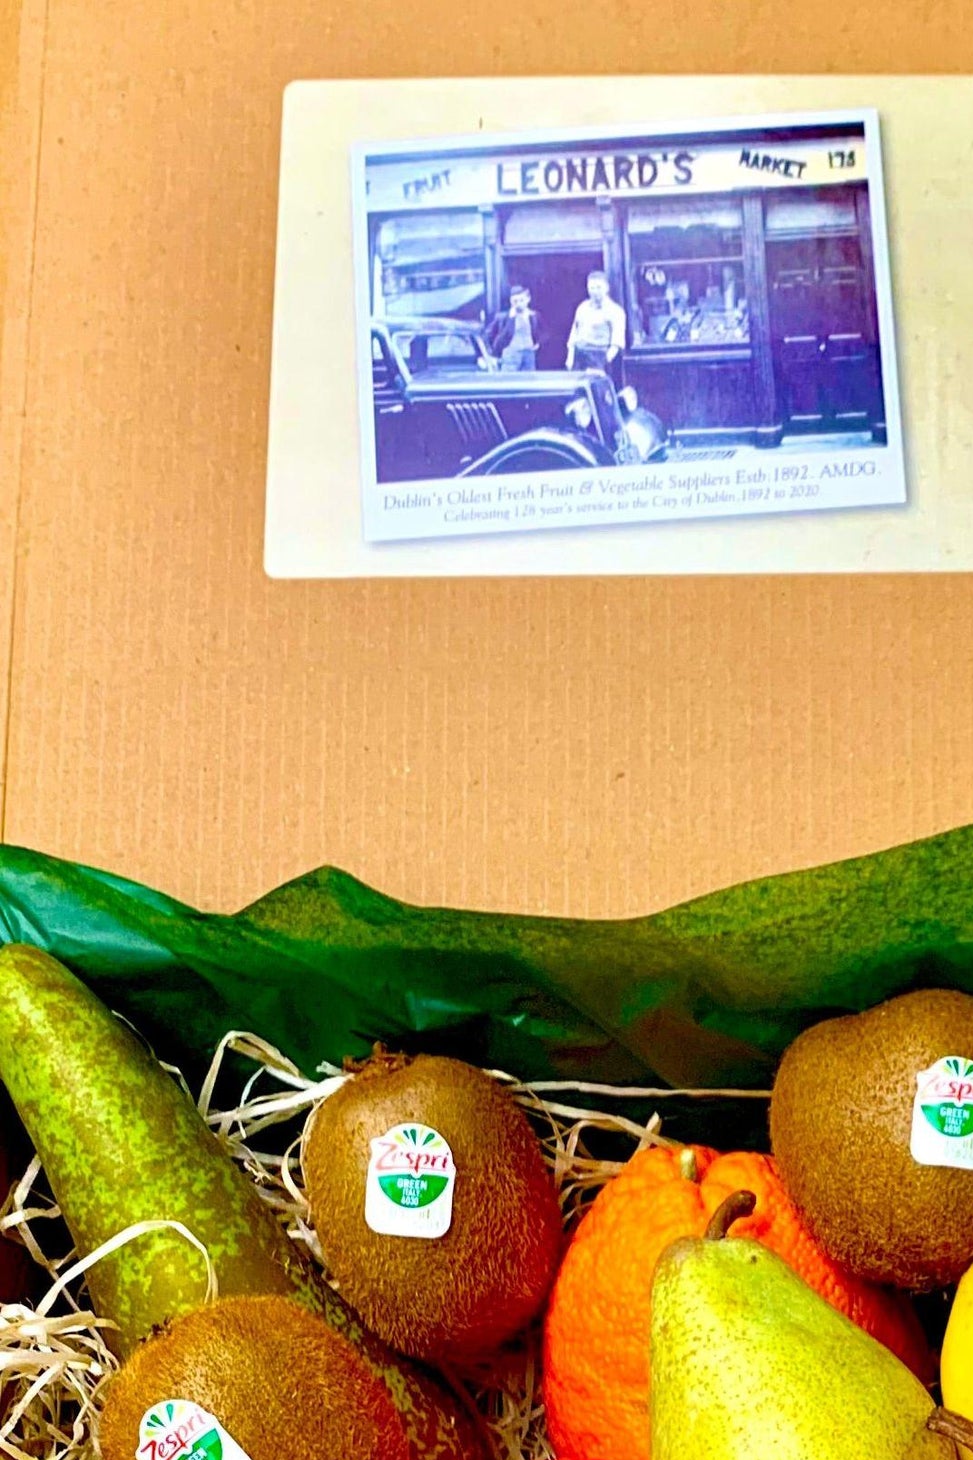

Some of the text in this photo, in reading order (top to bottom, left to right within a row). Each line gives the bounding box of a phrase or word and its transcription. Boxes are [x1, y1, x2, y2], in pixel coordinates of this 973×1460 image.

[402, 169, 451, 200] FRUIT
[497, 149, 694, 195] LEONARD'S
[739, 147, 807, 179] MARKET
[383, 493, 443, 511] Dublin's
[447, 489, 492, 506] Oldest
[498, 486, 535, 502] Fresh
[540, 483, 574, 499] Fruit
[579, 480, 593, 495] &
[598, 474, 663, 494] Vegetable
[669, 471, 730, 491] Suppliers
[444, 505, 510, 523] Celebrating
[540, 501, 573, 518] year's
[576, 500, 614, 514] service
[617, 499, 629, 510] to
[633, 496, 649, 509] the
[652, 494, 678, 510] City
[681, 493, 693, 507] of
[774, 487, 786, 500] to
[940, 1106, 970, 1119] GREEN
[397, 1178, 428, 1190] GREEN
